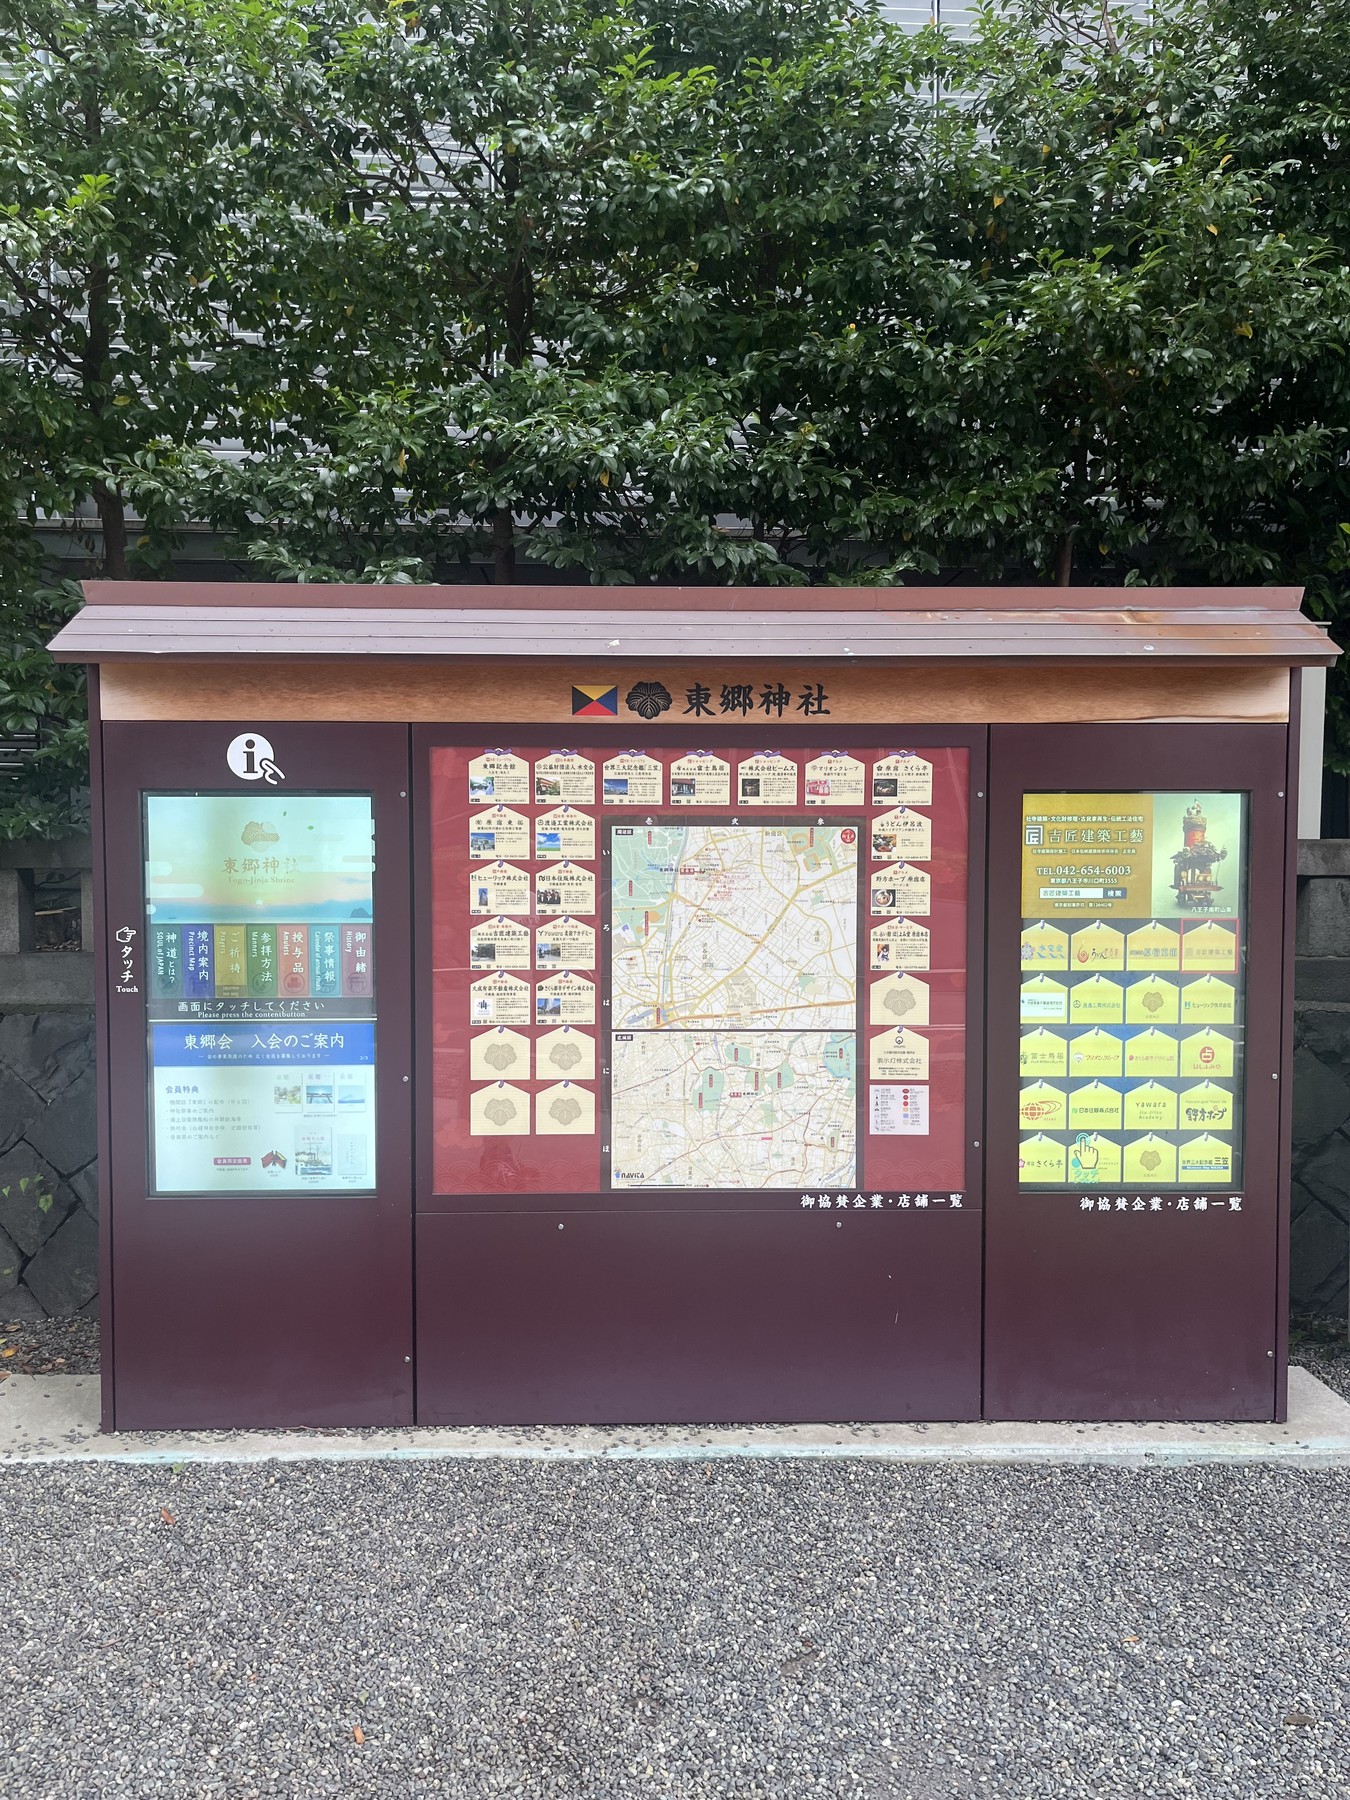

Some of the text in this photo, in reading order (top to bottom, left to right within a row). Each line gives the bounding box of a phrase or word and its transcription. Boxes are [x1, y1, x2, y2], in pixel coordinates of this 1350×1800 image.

[682, 683, 831, 717] 東郷神社
[1048, 829, 1143, 843] 吉匠建築工藝
[223, 857, 300, 874] 東郷神社
[345, 931, 353, 953] History
[197, 930, 209, 981] 境内案内
[229, 931, 241, 974] ご祈祷
[261, 932, 273, 982] 参拝方法
[292, 932, 304, 973] 授与品
[324, 931, 336, 982] 祭事情報
[355, 932, 367, 973] 御由緒
[121, 946, 134, 983] タッチ
[188, 957, 196, 971] Map
[115, 985, 139, 993] Touch
[178, 1001, 325, 1012] 画面にタッチしてください
[184, 1032, 345, 1050] 東郷会 入会のご案内
[165, 1085, 199, 1094] 会員特典
[1036, 1160, 1063, 1168] さくら亭
[1214, 1157, 1229, 1165] 三笠
[800, 1194, 963, 1209] 御協賛企業・店舗一覧
[1079, 1197, 1243, 1211] 御協賛企業・店舗一覧
